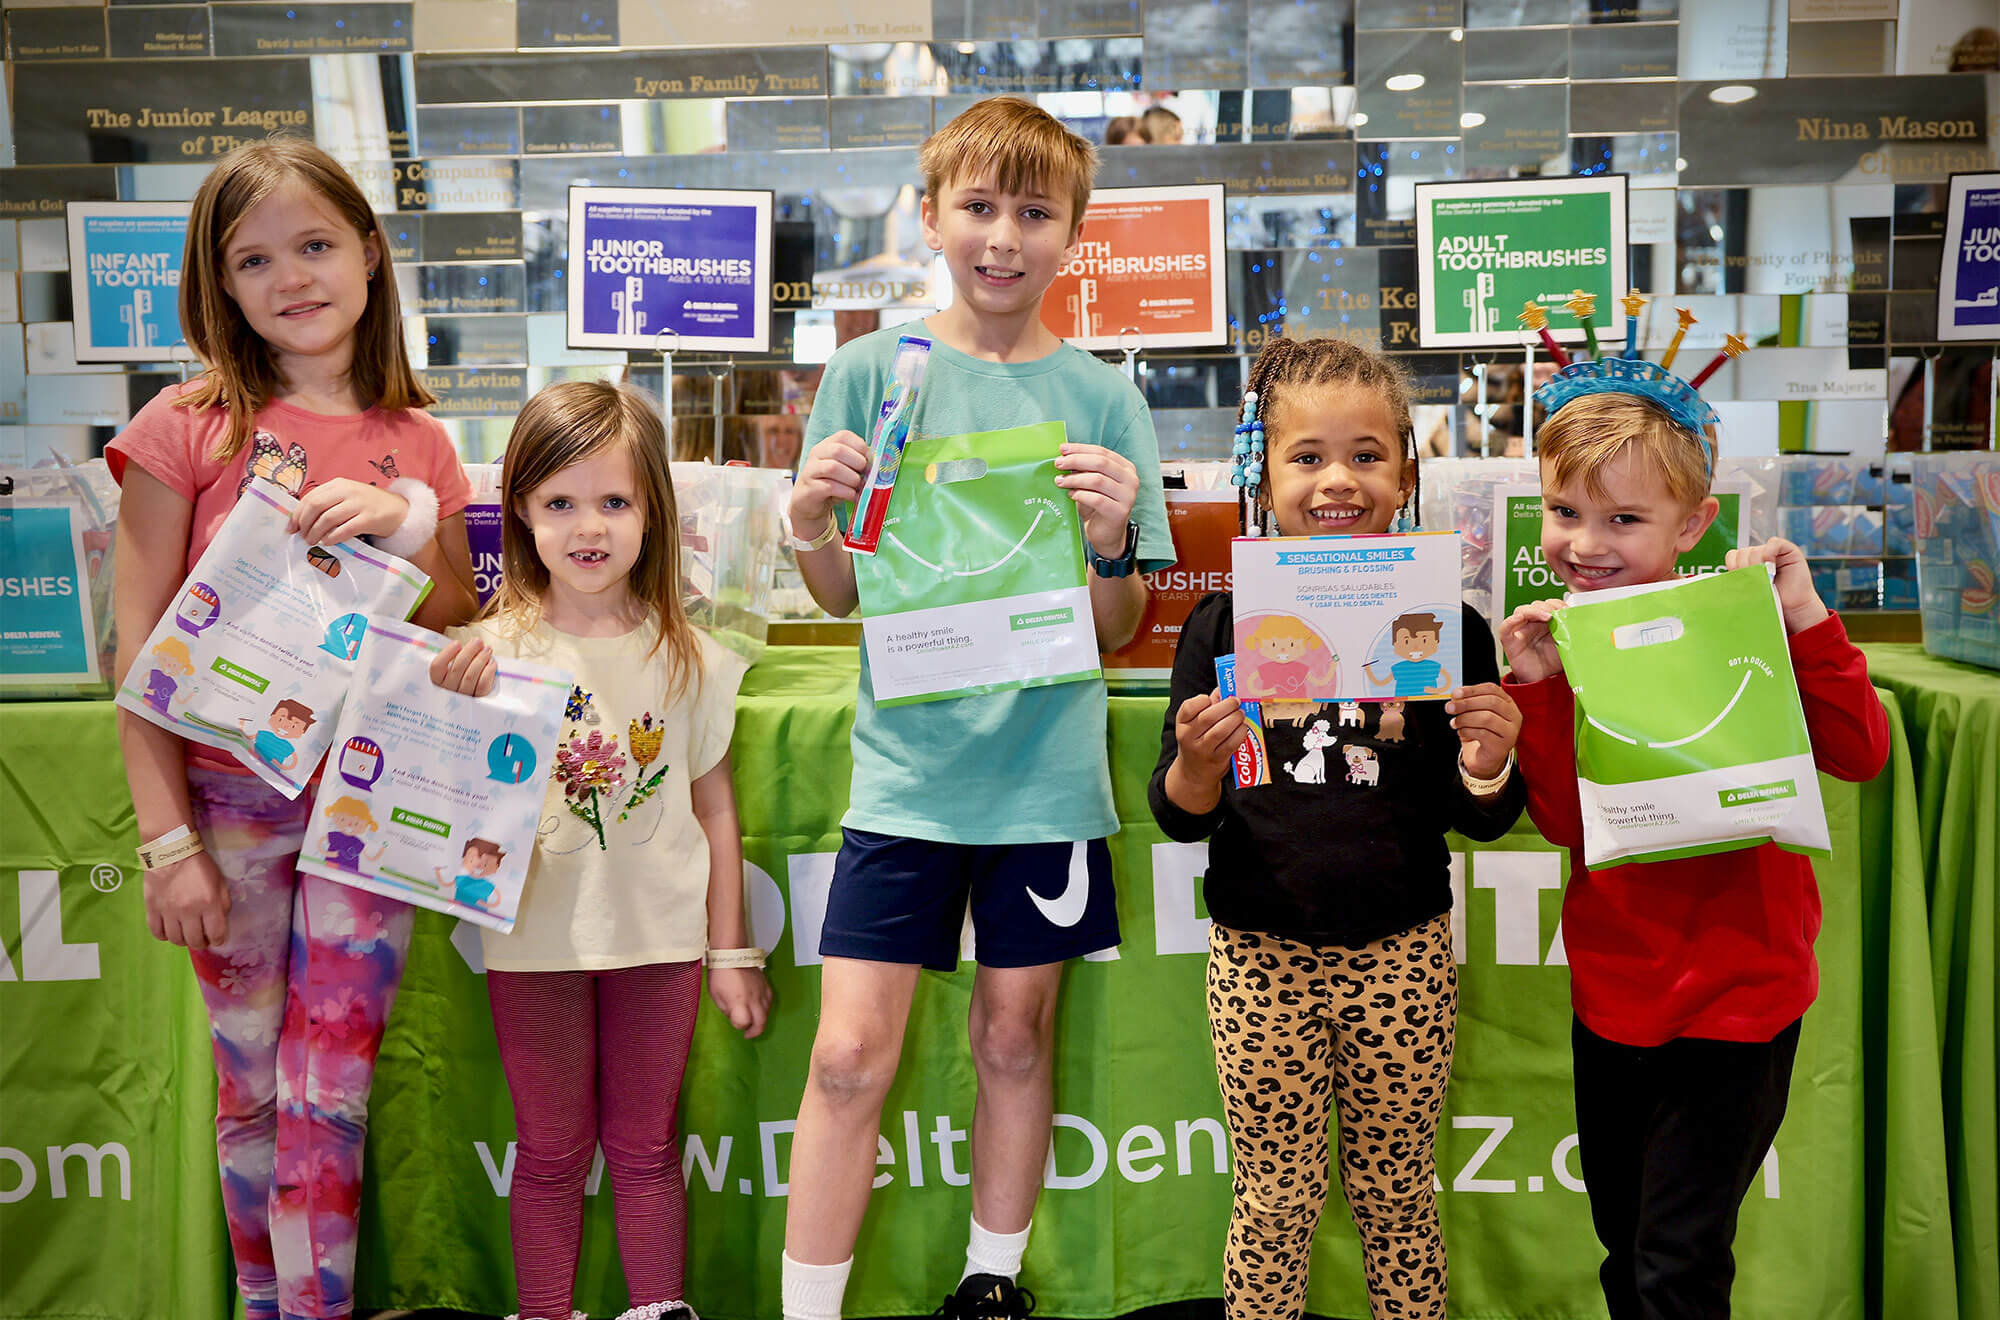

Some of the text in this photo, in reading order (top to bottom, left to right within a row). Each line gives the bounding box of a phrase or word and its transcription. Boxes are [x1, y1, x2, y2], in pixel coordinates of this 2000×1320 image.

[824, 24, 848, 35] and
[257, 38, 290, 48] David
[293, 38, 314, 48] and
[635, 74, 819, 95] Lyon Family Trust
[87, 107, 307, 130] The Junior League
[1231, 122, 1269, 135] Fund
[1797, 118, 1869, 140] Nina
[1879, 117, 1976, 138] Mason
[182, 136, 206, 154] of
[1858, 151, 2000, 175] Charitabl
[407, 164, 513, 184] Companies
[1254, 176, 1313, 187] Arizona
[1315, 175, 1347, 186] Kids
[401, 188, 513, 206] Foundation
[586, 239, 664, 258] JUNIOR
[1437, 234, 1508, 253] ADULT
[90, 253, 170, 270] INFANT
[587, 255, 752, 276] TOOTHBRUSHES
[1437, 247, 1607, 271] TOOTHBRUSHES
[1791, 251, 1808, 265] of
[1813, 250, 1883, 265] Phoenix
[91, 270, 181, 287] TOOTHB
[702, 276, 714, 284] TO
[1785, 271, 1883, 287] Foundation
[773, 281, 927, 306] onymous
[1318, 288, 1371, 310] The
[457, 373, 521, 388] Levine
[1786, 381, 1818, 393] Tina
[1287, 550, 1405, 563] SENSATIONAL SMILES
[1298, 563, 1395, 575] BRUSHING & FLOSSING
[1297, 582, 1395, 593] SONRISAS SALUDABLES
[1154, 592, 1190, 601] YEARS
[4, 630, 62, 639] DELTA DENTAL
[886, 626, 954, 643] A healthy smile
[887, 644, 895, 653] is
[905, 638, 945, 653] powerful
[947, 634, 973, 645] thing.
[1728, 656, 1742, 667] GOT
[1224, 667, 1234, 692] cavity
[1630, 802, 1655, 812] smile
[1649, 812, 1676, 822] thing.
